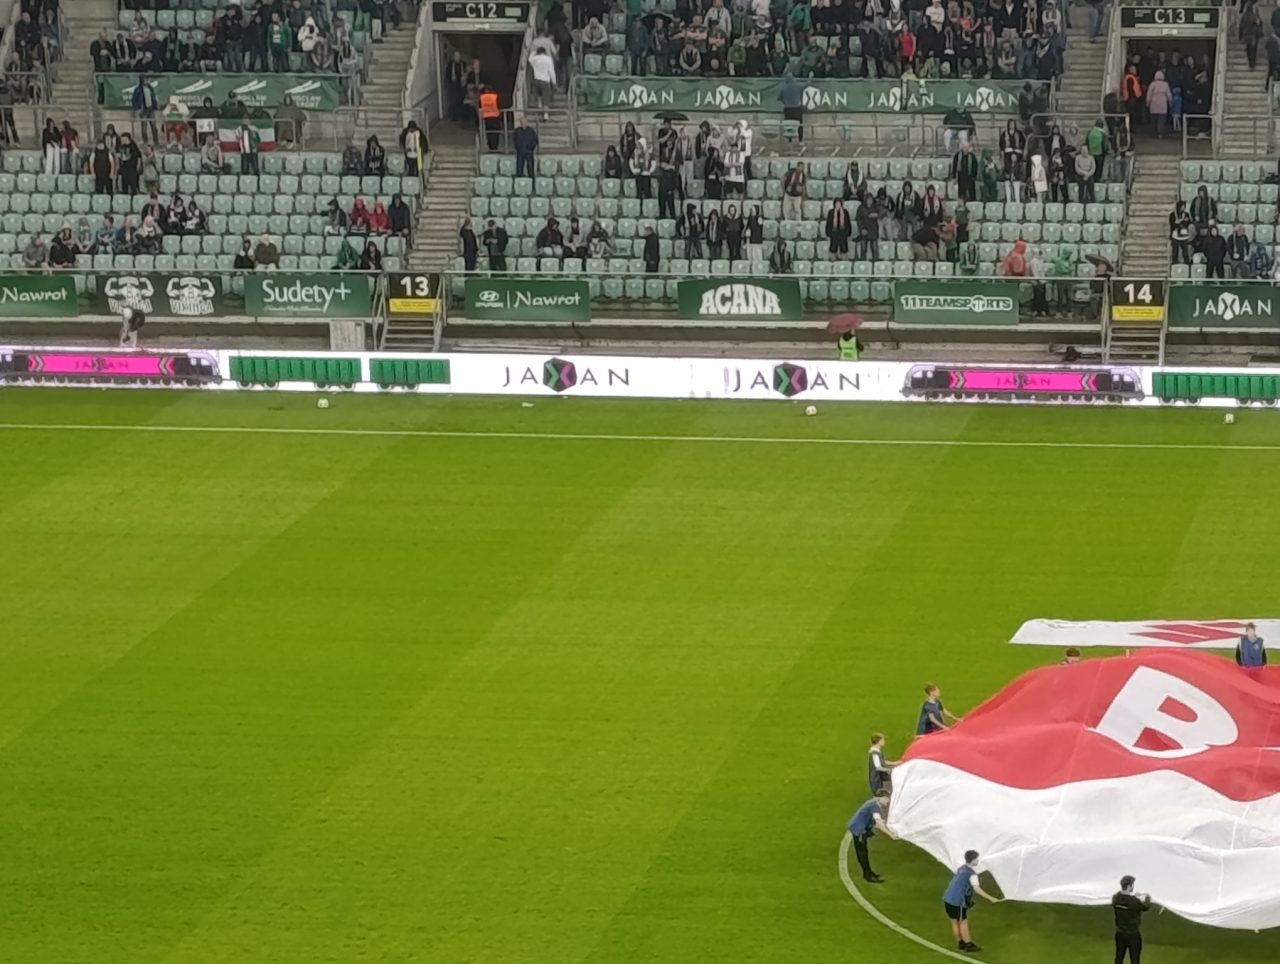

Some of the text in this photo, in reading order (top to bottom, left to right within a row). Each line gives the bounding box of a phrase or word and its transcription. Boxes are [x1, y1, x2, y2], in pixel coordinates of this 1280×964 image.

[466, 3, 497, 18] C12
[1154, 9, 1185, 23] C13
[608, 84, 674, 108] JAXAN
[695, 85, 761, 109] JAXAN
[803, 86, 848, 110] XAN
[2, 286, 68, 304] Nawrot
[262, 279, 352, 313] Sudety+
[400, 276, 429, 296] 13
[1124, 283, 1153, 303] 14
[513, 291, 581, 308] Nawrot
[699, 283, 782, 314] ACANA
[1193, 292, 1272, 320] JAXAN
[503, 357, 630, 392] JAXAN
[732, 362, 860, 398] JAXAN
